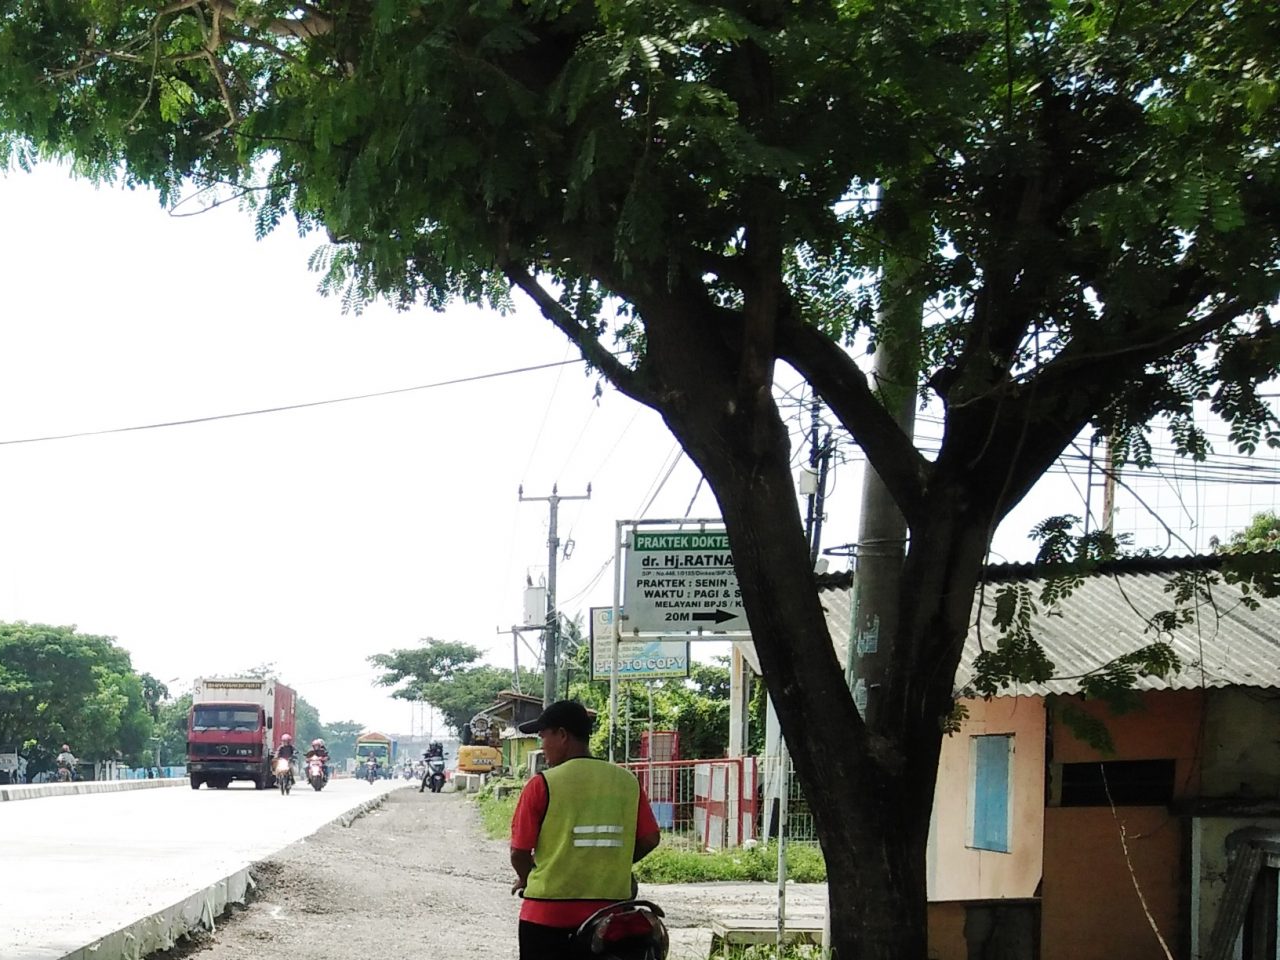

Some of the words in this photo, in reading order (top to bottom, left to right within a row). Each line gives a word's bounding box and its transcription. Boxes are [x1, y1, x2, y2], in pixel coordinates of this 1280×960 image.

[637, 537, 688, 548] PRAKTEK
[692, 536, 729, 548] DOKTE
[642, 556, 659, 566] dr.
[636, 579, 686, 588] PRAKTEK
[695, 579, 728, 587] SENIN
[644, 590, 684, 598] WAKTU
[694, 589, 719, 598] PAGI
[722, 590, 731, 598] &
[734, 589, 742, 598] S
[665, 612, 690, 621] 20M
[646, 657, 685, 669] COPY
[267, 687, 273, 696] A
